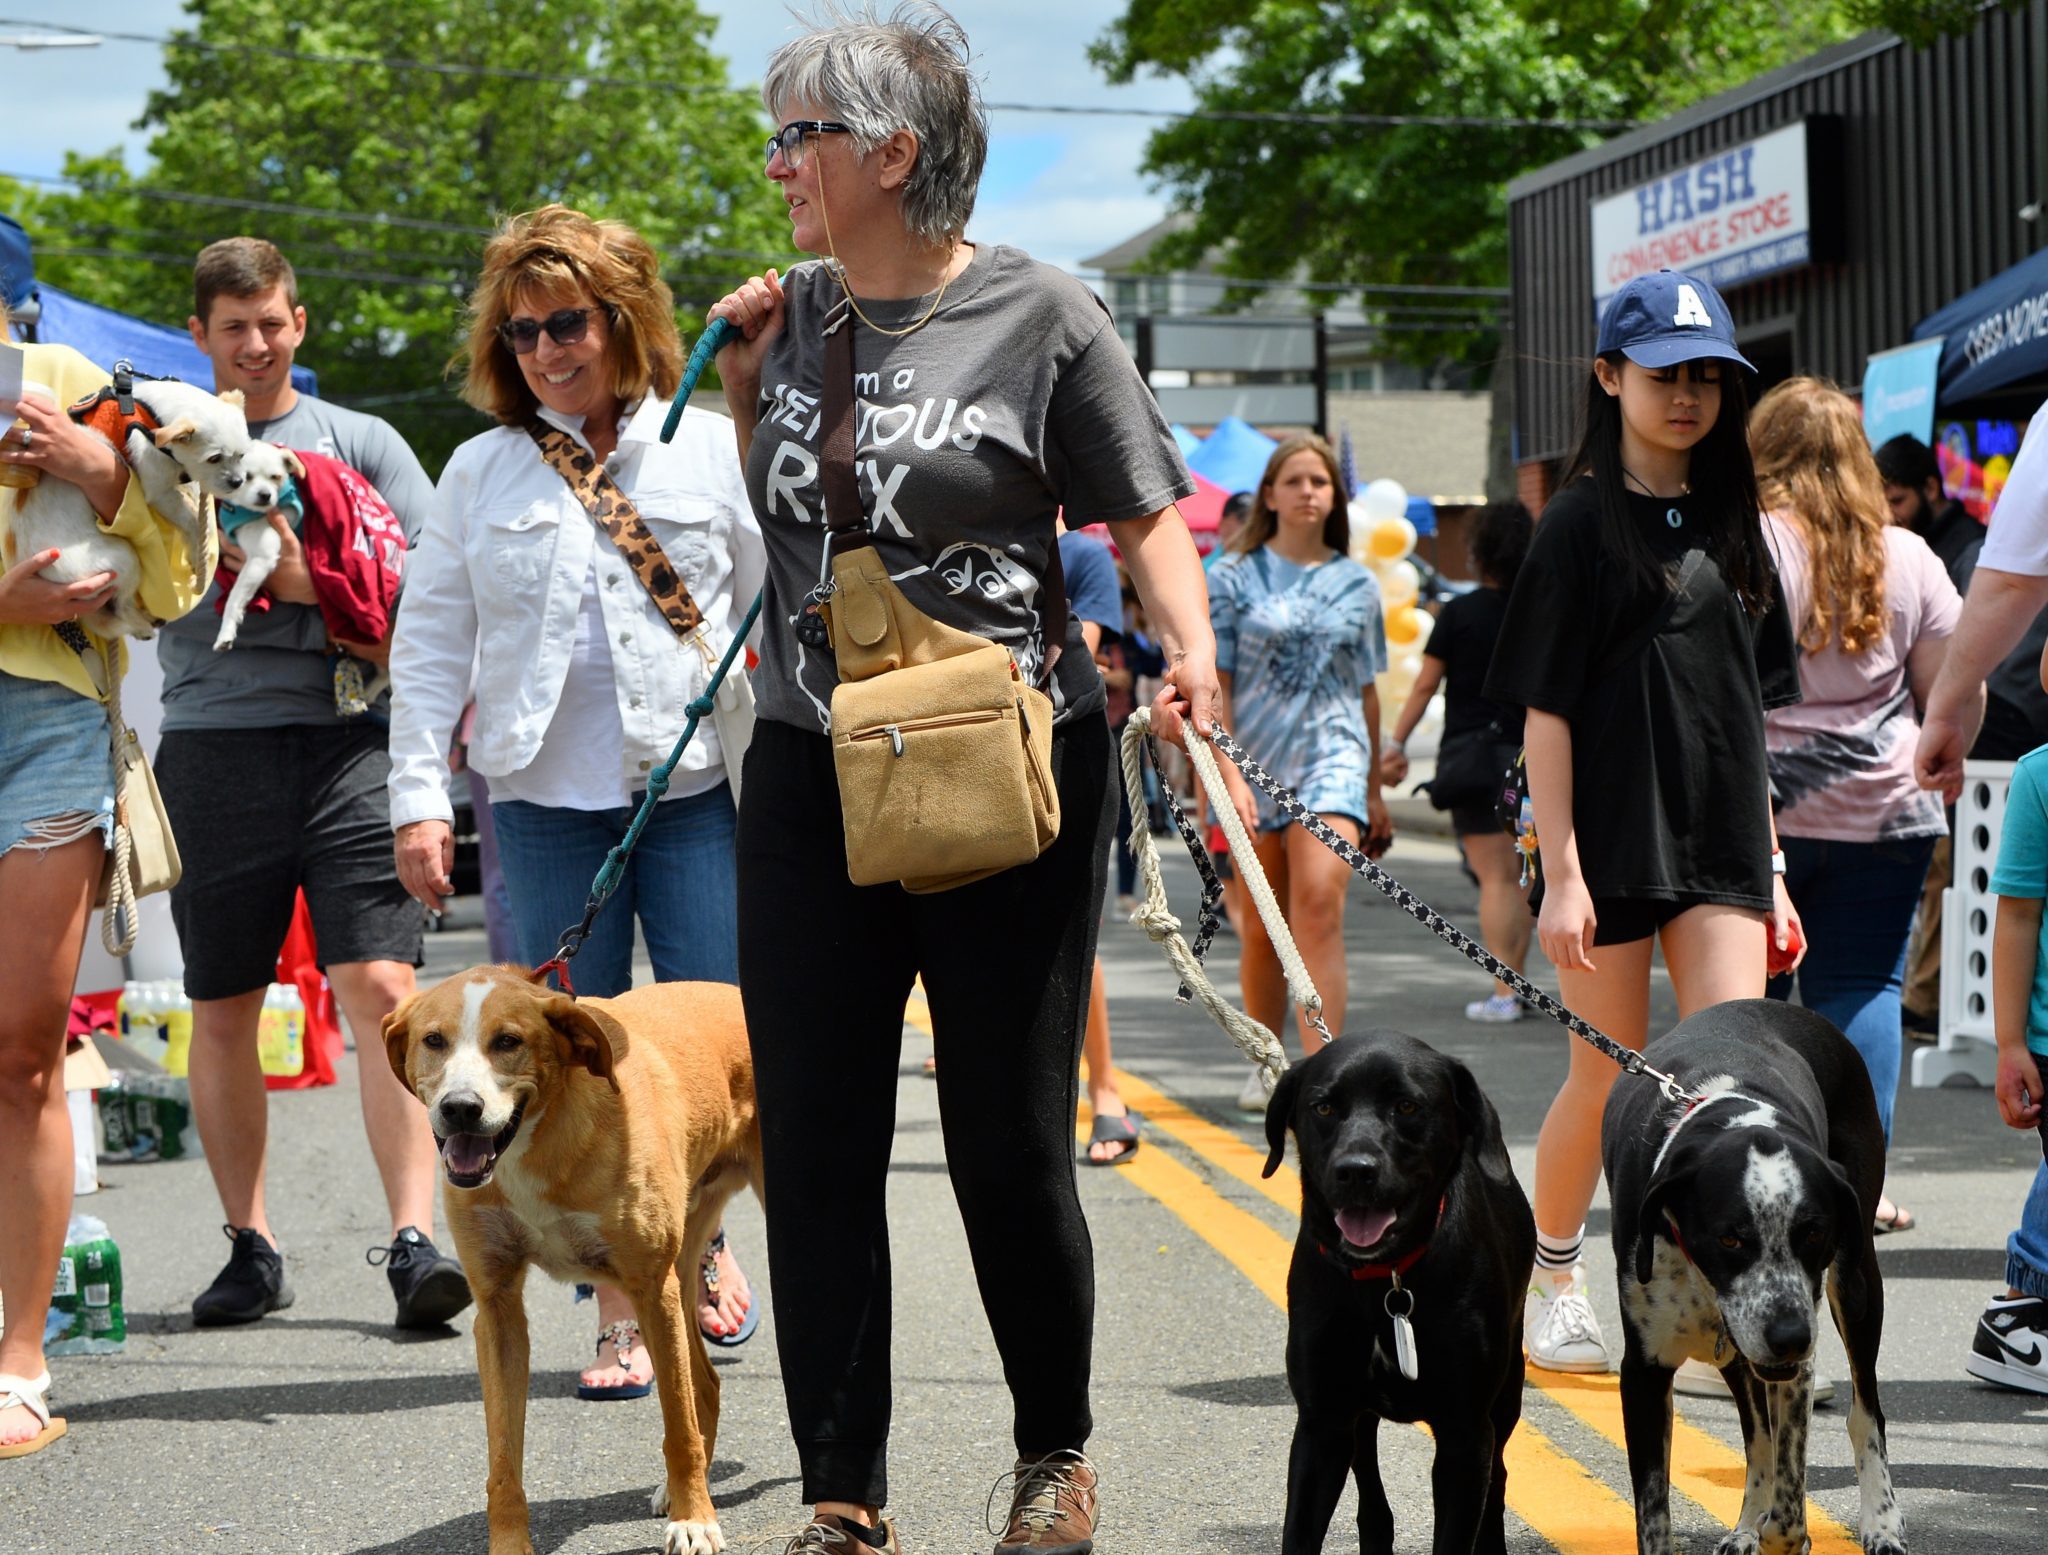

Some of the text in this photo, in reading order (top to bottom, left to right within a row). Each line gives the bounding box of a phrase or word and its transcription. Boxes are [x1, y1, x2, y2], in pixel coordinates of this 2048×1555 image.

[1636, 147, 1755, 236] HASH
[1728, 191, 1791, 244] STORE
[1674, 284, 1712, 328] A
[893, 368, 915, 390] a
[766, 440, 915, 538] RX
